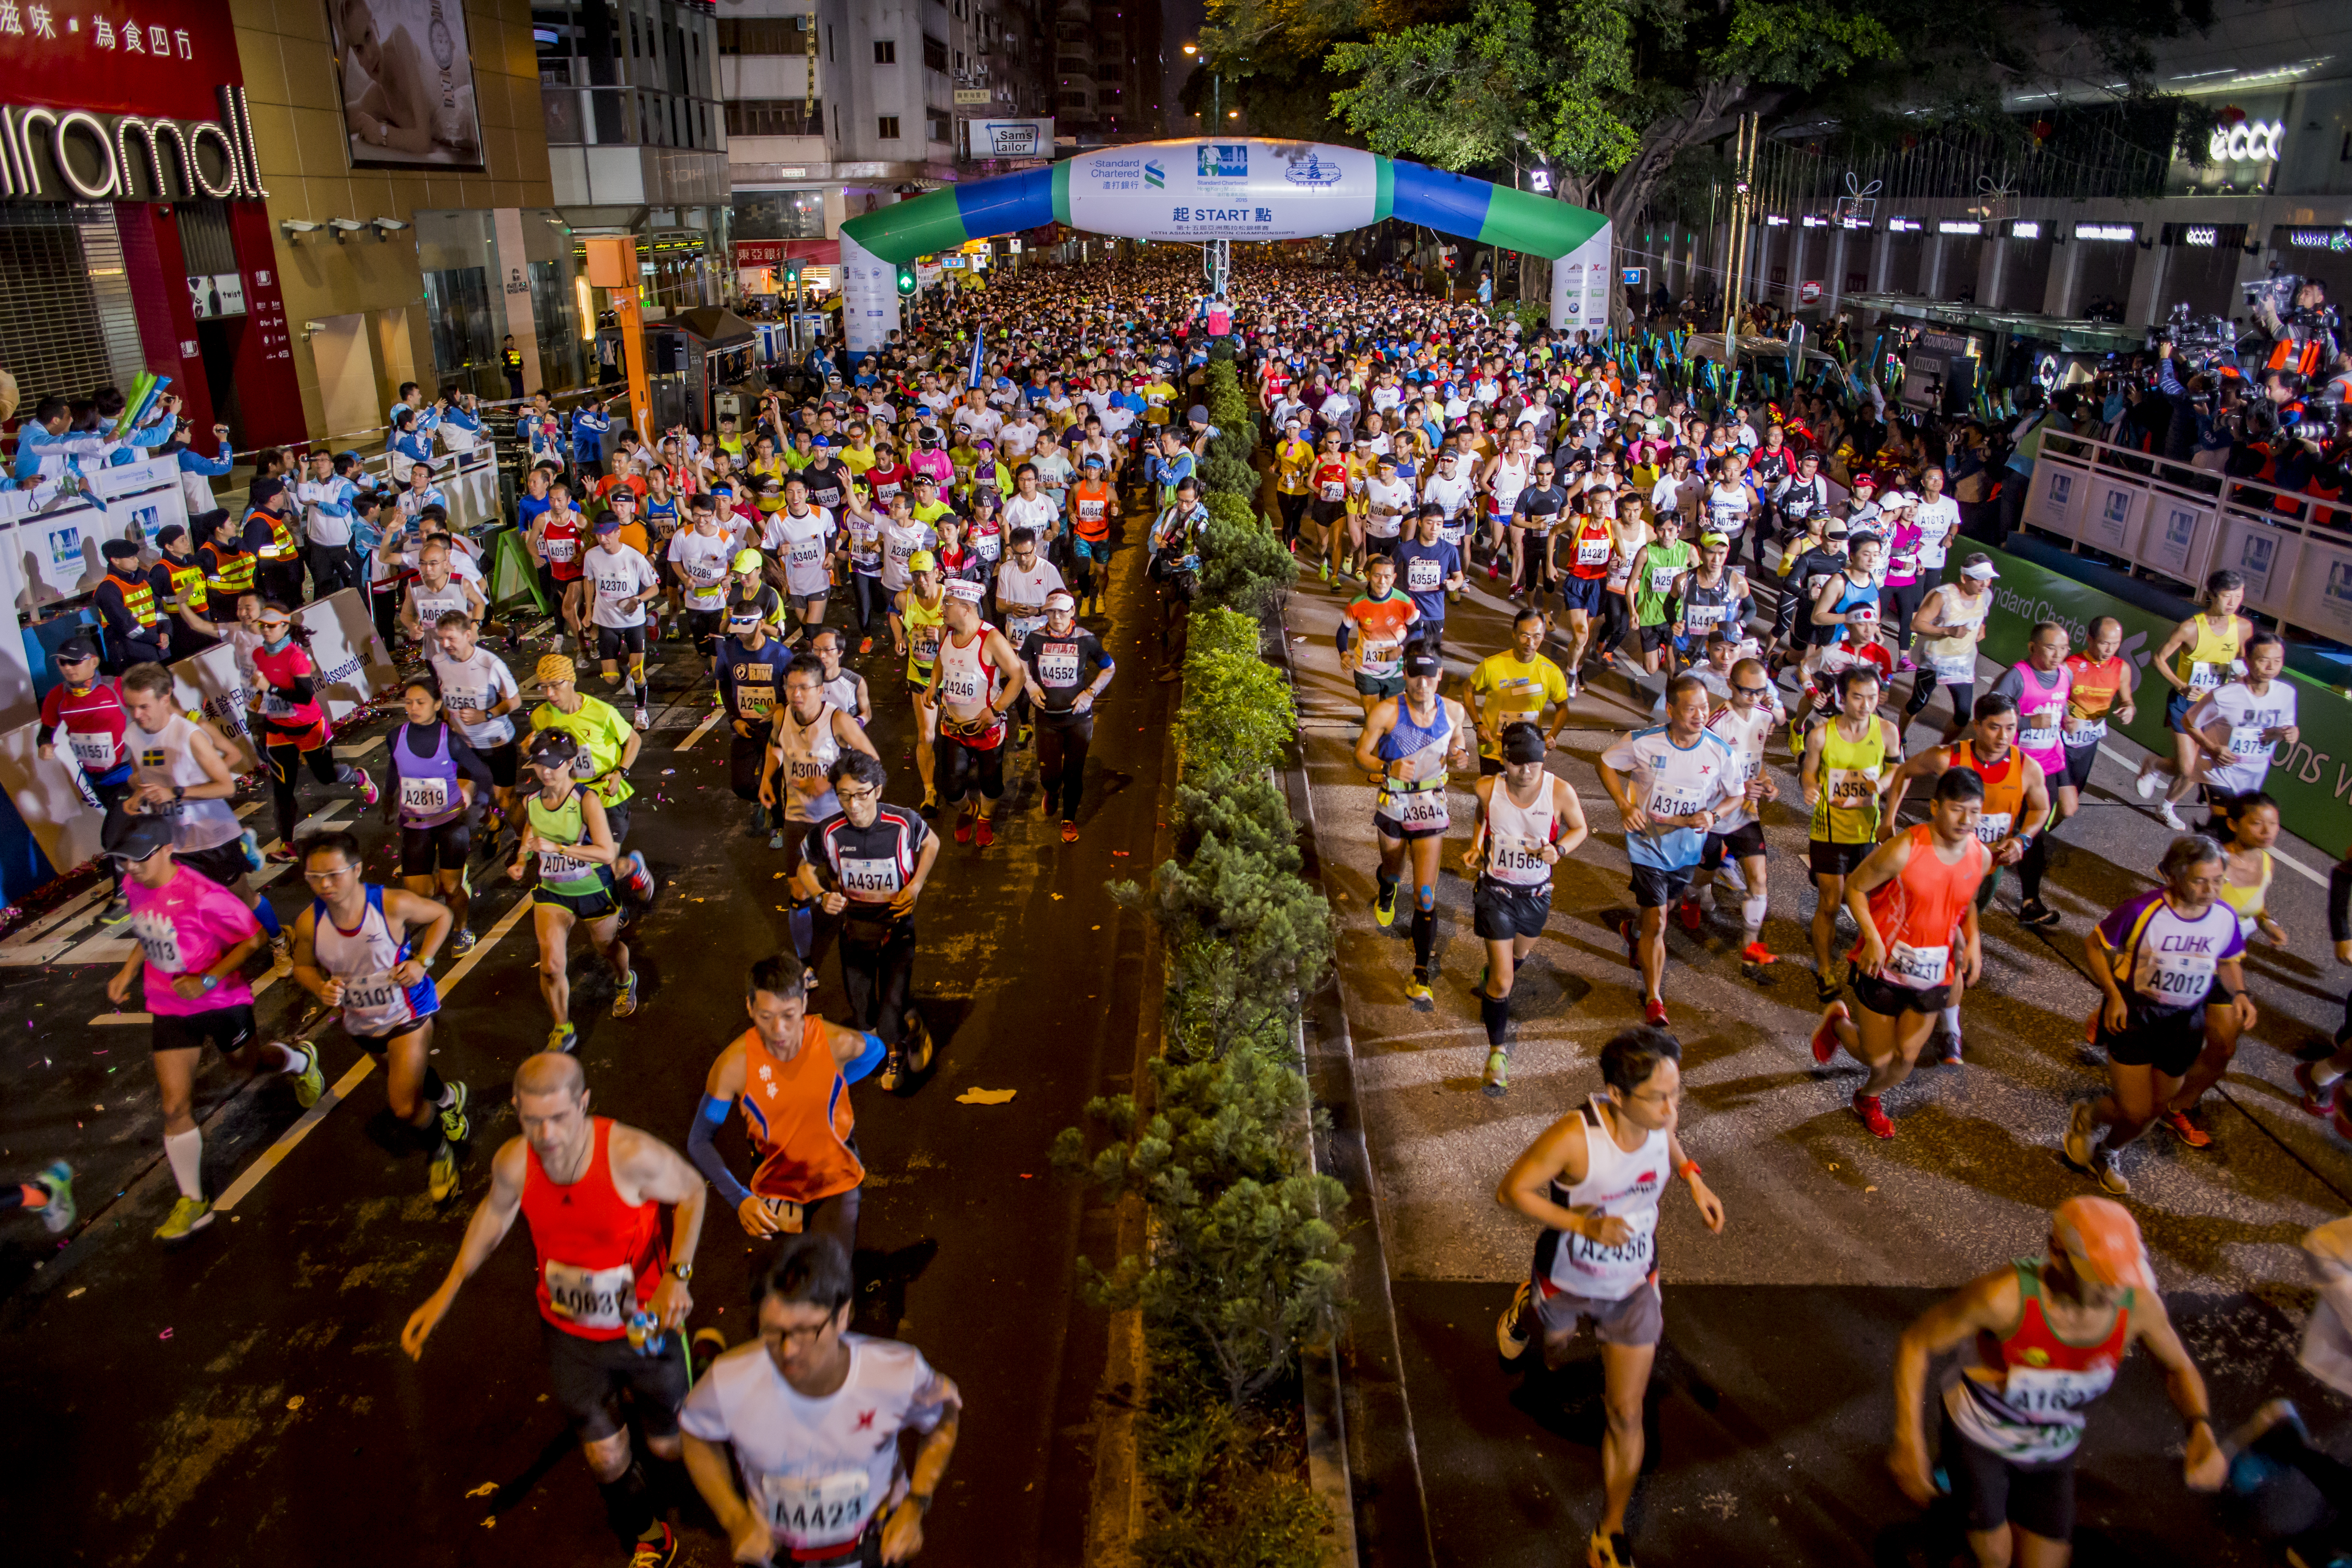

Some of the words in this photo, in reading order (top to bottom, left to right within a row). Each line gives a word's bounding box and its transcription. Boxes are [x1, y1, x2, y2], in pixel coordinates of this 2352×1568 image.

[1000, 130, 1032, 140] Sam's
[995, 138, 1027, 152] tailor
[1091, 169, 1139, 177] Chartered
[1173, 207, 1189, 221] 起
[1195, 209, 1250, 221] START
[1255, 208, 1271, 222] 點
[2187, 230, 2215, 244] ecco
[2291, 234, 2328, 245] LACOSTE
[738, 248, 787, 260] 東亞銀行
[1924, 334, 1965, 352] COUNTDOWN
[1914, 356, 1941, 372] CITIZEN
[1284, 475, 1302, 484] A0873
[818, 494, 838, 504] A3439
[1081, 508, 1102, 516] A0842
[1371, 505, 1386, 516] A084
[1921, 515, 1945, 525] A1813
[550, 547, 574, 557] A0513
[793, 549, 818, 562] A3404
[1581, 549, 1606, 559] A4221
[688, 565, 711, 579] A2289
[1410, 573, 1437, 585] A3554
[600, 580, 627, 592] A2370
[192, 589, 205, 598] CAS
[914, 640, 938, 654] A424
[324, 656, 372, 685] Association
[749, 669, 773, 681] RAW
[1043, 666, 1074, 680] A4552
[944, 680, 974, 696] A4246
[445, 695, 476, 709] A2563
[74, 744, 109, 759] A1557
[791, 761, 829, 778] A3003
[404, 790, 444, 806] A2819
[1403, 805, 1444, 821] A3644
[1652, 795, 1697, 817] A3183
[1497, 849, 1544, 869] A1565
[848, 872, 894, 891] A4374
[2161, 936, 2216, 953] CUHK
[2148, 969, 2205, 994] A2012
